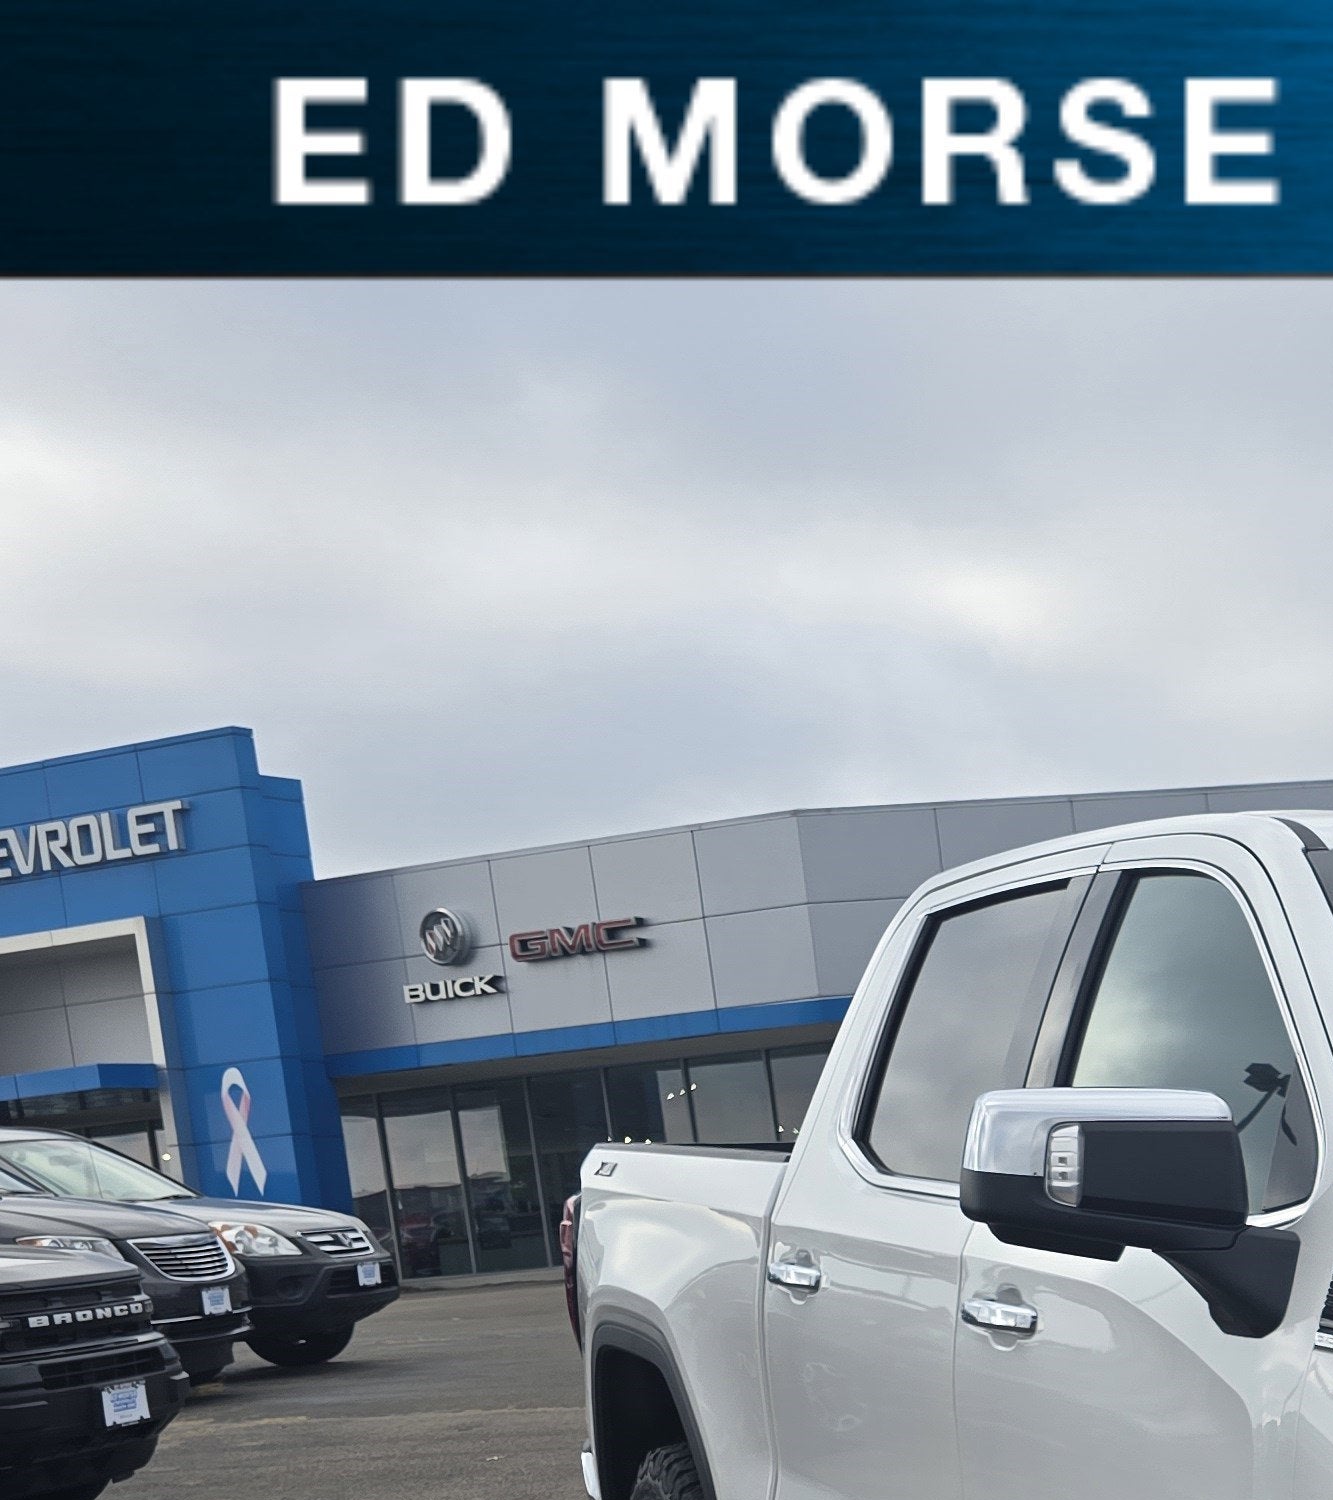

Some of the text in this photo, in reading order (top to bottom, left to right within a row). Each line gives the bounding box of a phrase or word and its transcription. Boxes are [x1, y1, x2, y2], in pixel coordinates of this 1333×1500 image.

[508, 918, 638, 962] GMC
[403, 975, 498, 1004] BUICK
[28, 1303, 143, 1328] BRONCO
